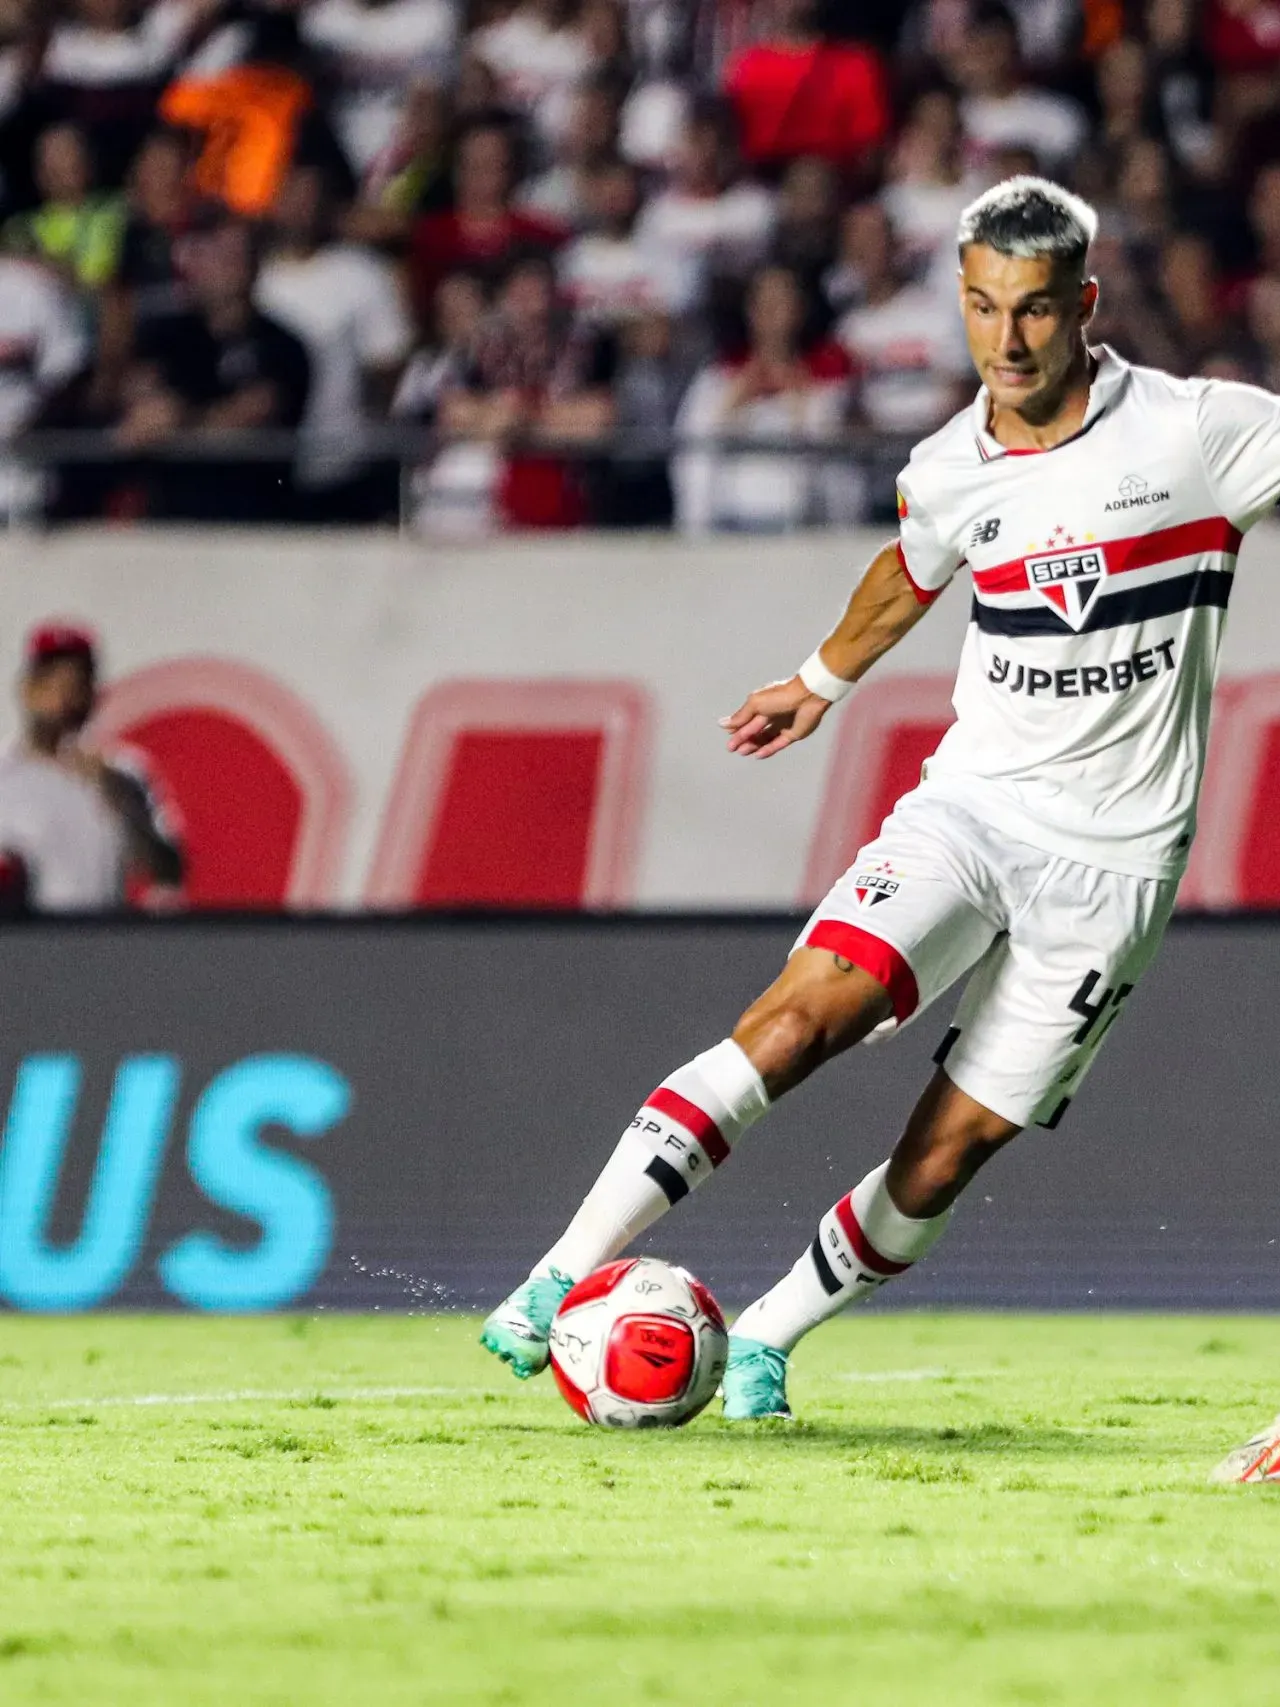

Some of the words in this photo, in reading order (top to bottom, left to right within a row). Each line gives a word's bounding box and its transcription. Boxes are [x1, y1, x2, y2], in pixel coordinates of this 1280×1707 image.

[1103, 490, 1170, 513] ADEMICON
[1032, 554, 1099, 581] SPFC
[856, 876, 900, 893] SPFC
[1067, 969, 1134, 1049] 4
[0, 1050, 354, 1314] US
